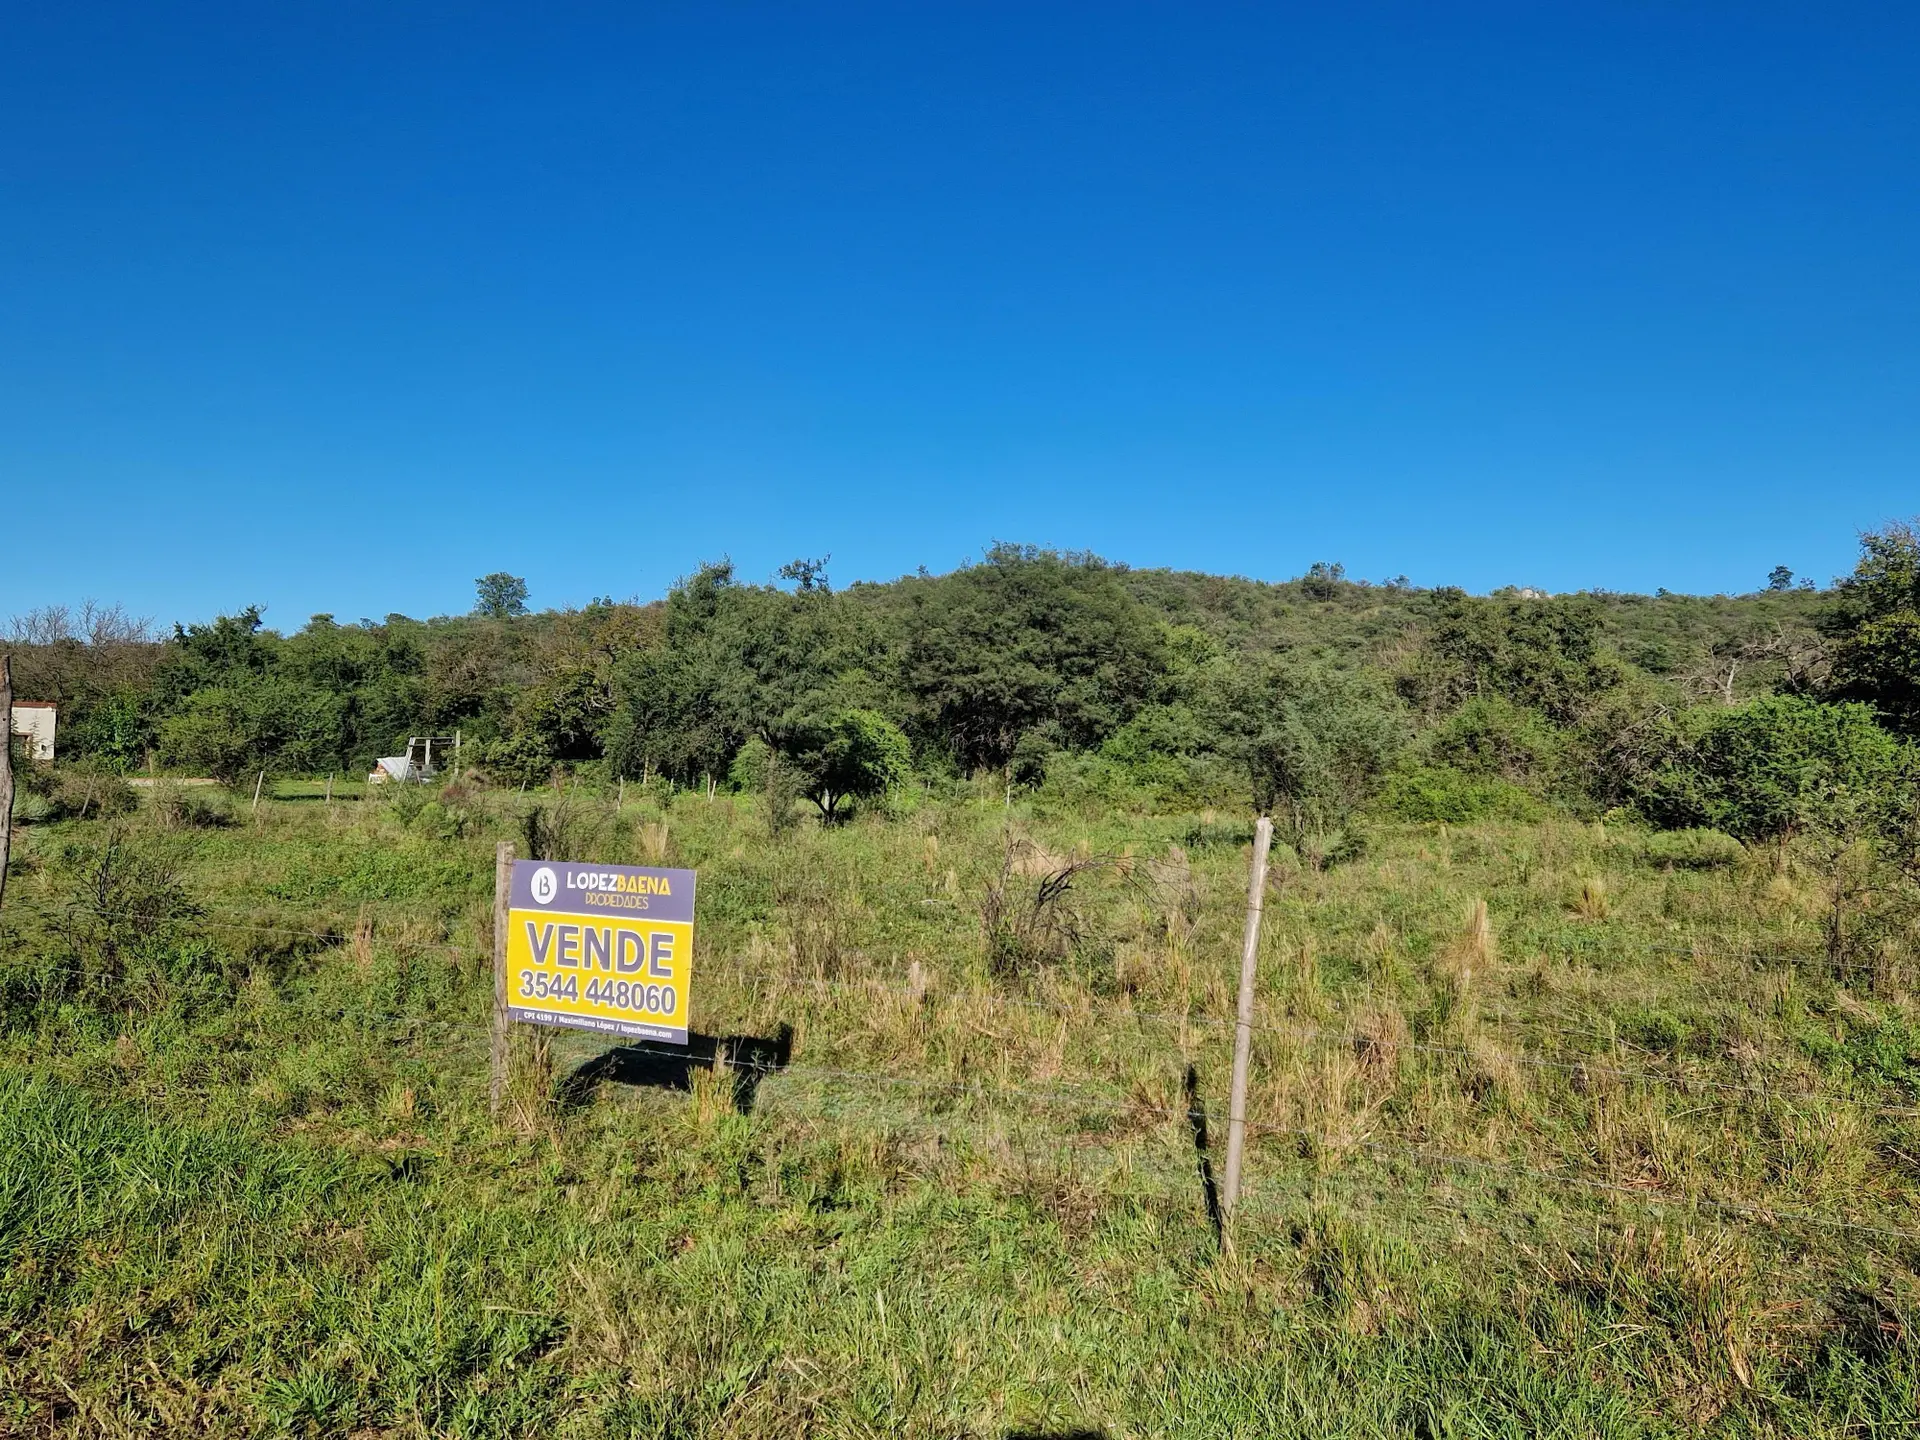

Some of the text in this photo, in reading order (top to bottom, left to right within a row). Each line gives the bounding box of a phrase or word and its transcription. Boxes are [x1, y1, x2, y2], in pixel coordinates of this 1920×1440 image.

[525, 921, 675, 978] VENDE
[520, 970, 677, 1016] 3544 448060
[523, 1011, 536, 1020] CPI
[536, 1013, 552, 1022] 4199
[559, 1015, 596, 1028] Maximiliano
[596, 1020, 615, 1031] López
[621, 1024, 672, 1039] lopezbaena.com
